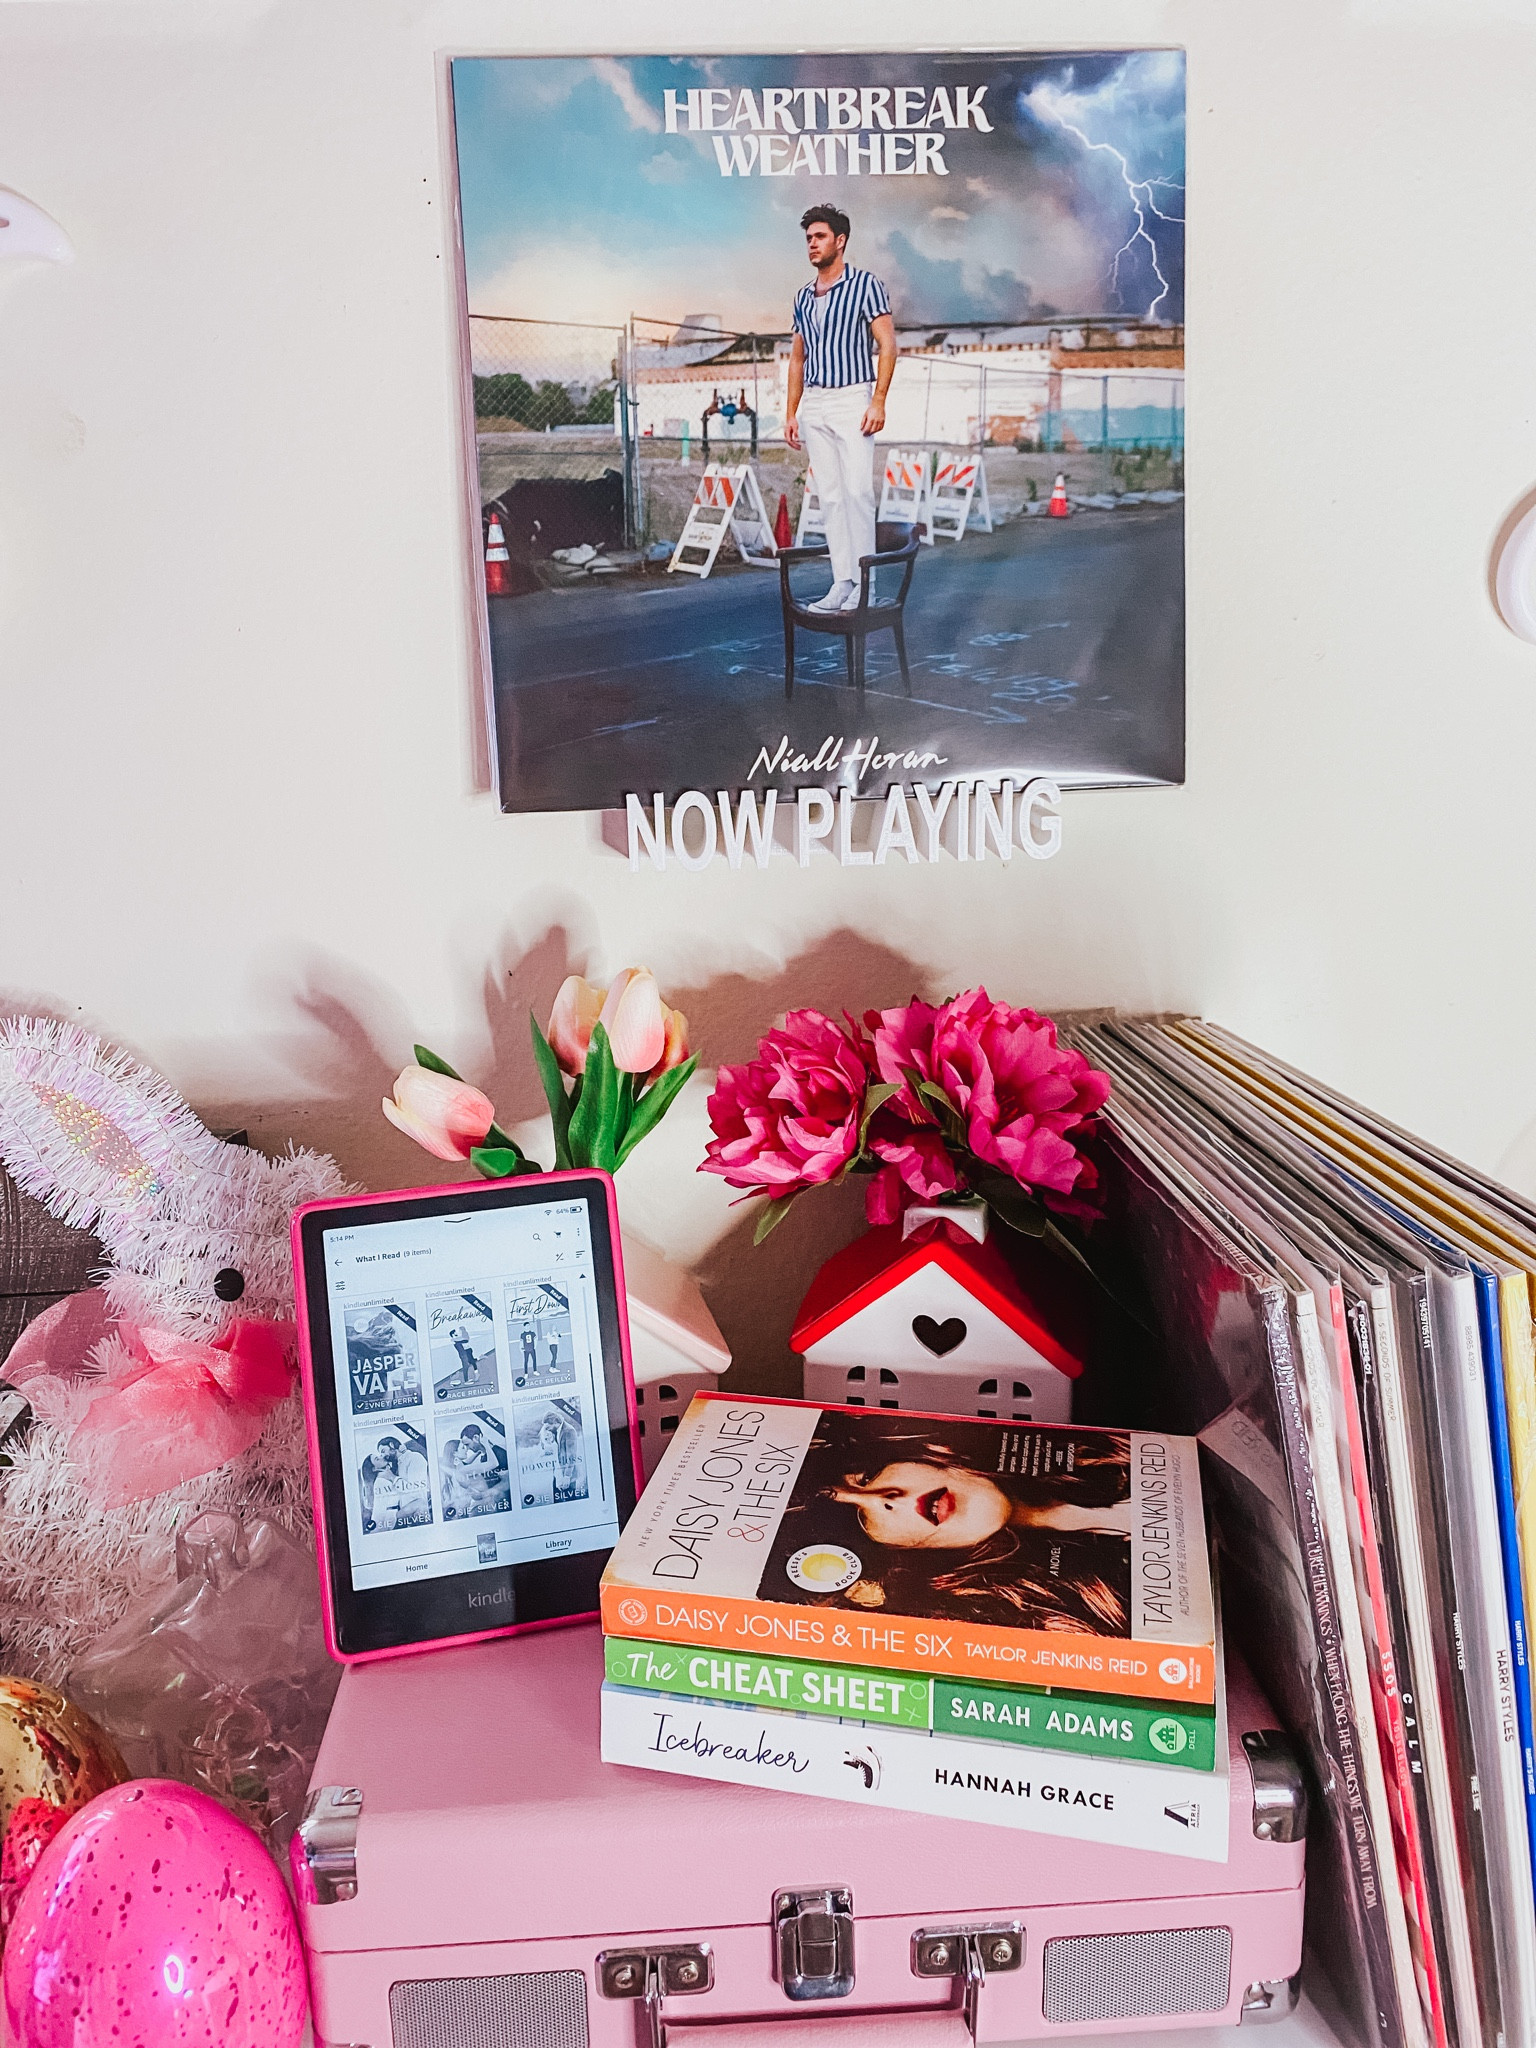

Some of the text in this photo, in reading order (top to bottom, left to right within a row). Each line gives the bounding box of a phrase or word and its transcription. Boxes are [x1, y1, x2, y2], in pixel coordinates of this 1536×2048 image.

[664, 85, 994, 134] HEARTBREAK
[713, 134, 950, 177] WEATHER
[748, 734, 947, 780] Niall Horan
[625, 777, 1062, 872] NOW PLAYING
[556, 1207, 570, 1216] 64%
[330, 1236, 344, 1244] 5:14
[356, 1254, 374, 1264] What
[382, 1252, 401, 1261] Read
[403, 1250, 411, 1258] (9
[412, 1247, 432, 1258] items)
[344, 1297, 394, 1310] kindleunlimited
[473, 1300, 486, 1311] Read
[550, 1289, 563, 1300] Read
[396, 1310, 410, 1322] Read
[525, 1334, 532, 1344] 9
[352, 1352, 415, 1374] JASPER
[1464, 1325, 1476, 1382] 88985 439031
[352, 1368, 418, 1396] VALE
[525, 1380, 543, 1388] RACE
[1379, 1330, 1390, 1369] SECONDS
[1385, 1387, 1397, 1422] SUMMER
[364, 1400, 390, 1410] EVNEY
[448, 1391, 466, 1399] RACE
[562, 1404, 576, 1416] Read
[406, 1428, 420, 1440] Read
[554, 1489, 587, 1500] SILVER
[638, 1424, 706, 1548] NEW YORK TIMES BESTSELLER
[652, 1409, 766, 1580] DAISY JONES
[727, 1442, 800, 1542] & THE SIX
[398, 1514, 431, 1526] SILVER
[478, 1500, 510, 1513] SILVER
[545, 1538, 573, 1550] Library
[1140, 1442, 1172, 1626] TAYLOR JENKINS REID
[406, 1562, 428, 1572] Home
[834, 1552, 858, 1587] BOOK CLUB
[1050, 1546, 1061, 1570] NOVEL
[1178, 1574, 1188, 1584] OF
[467, 1587, 516, 1608] kindle
[1178, 1586, 1190, 1616] AUTHOR
[656, 1604, 728, 1633] DAISY
[735, 1614, 826, 1644] JONES
[832, 1624, 852, 1647] &
[856, 1626, 906, 1654] THE
[914, 1633, 953, 1659] SIX
[964, 1642, 1027, 1663] TAYLOR
[1031, 1650, 1104, 1672] JENKINS
[1108, 1658, 1148, 1676] REID
[1452, 1612, 1466, 1670] HARRY STYLES
[1514, 1620, 1525, 1666] HARRY STYLES
[1325, 1646, 1341, 1682] WHEN
[1382, 1651, 1398, 1698] 5SOS
[627, 1651, 906, 1716] The CHEAT SHEET
[1496, 1649, 1515, 1742] HARRY STYLES
[1330, 1681, 1348, 1726] FACING
[950, 1697, 1134, 1742] SARAH ADAMS
[648, 1712, 810, 1774] Icebreaker
[1188, 1729, 1196, 1750] DELL
[1338, 1726, 1353, 1752] THE
[1342, 1753, 1362, 1795] THINGS
[935, 1768, 1114, 1812] HANNAH GRACE
[1350, 1794, 1363, 1812] WE
[1352, 1815, 1367, 1842] TURN
[1357, 1842, 1372, 1872] AWAY
[1362, 1874, 1378, 1910] FROM
